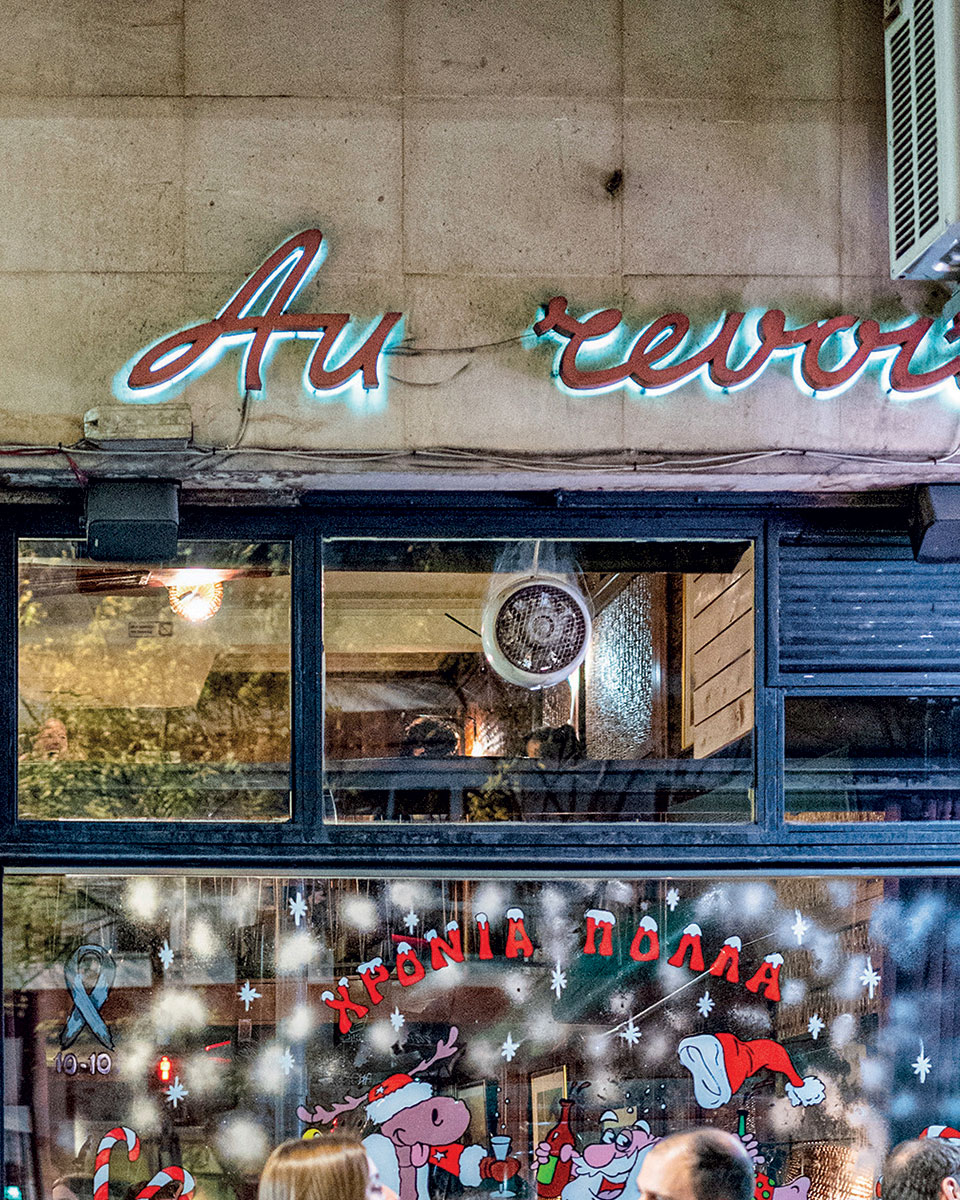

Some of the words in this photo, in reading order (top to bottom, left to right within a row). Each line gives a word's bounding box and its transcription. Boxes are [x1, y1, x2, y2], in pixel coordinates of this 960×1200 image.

[122, 228, 404, 398] Au
[533, 294, 960, 397] revoi
[321, 907, 534, 1034] ΧΡΟΝΙΑ
[583, 909, 785, 1002] ΠΟΛΛΑ
[54, 1052, 112, 1075] 10-10
